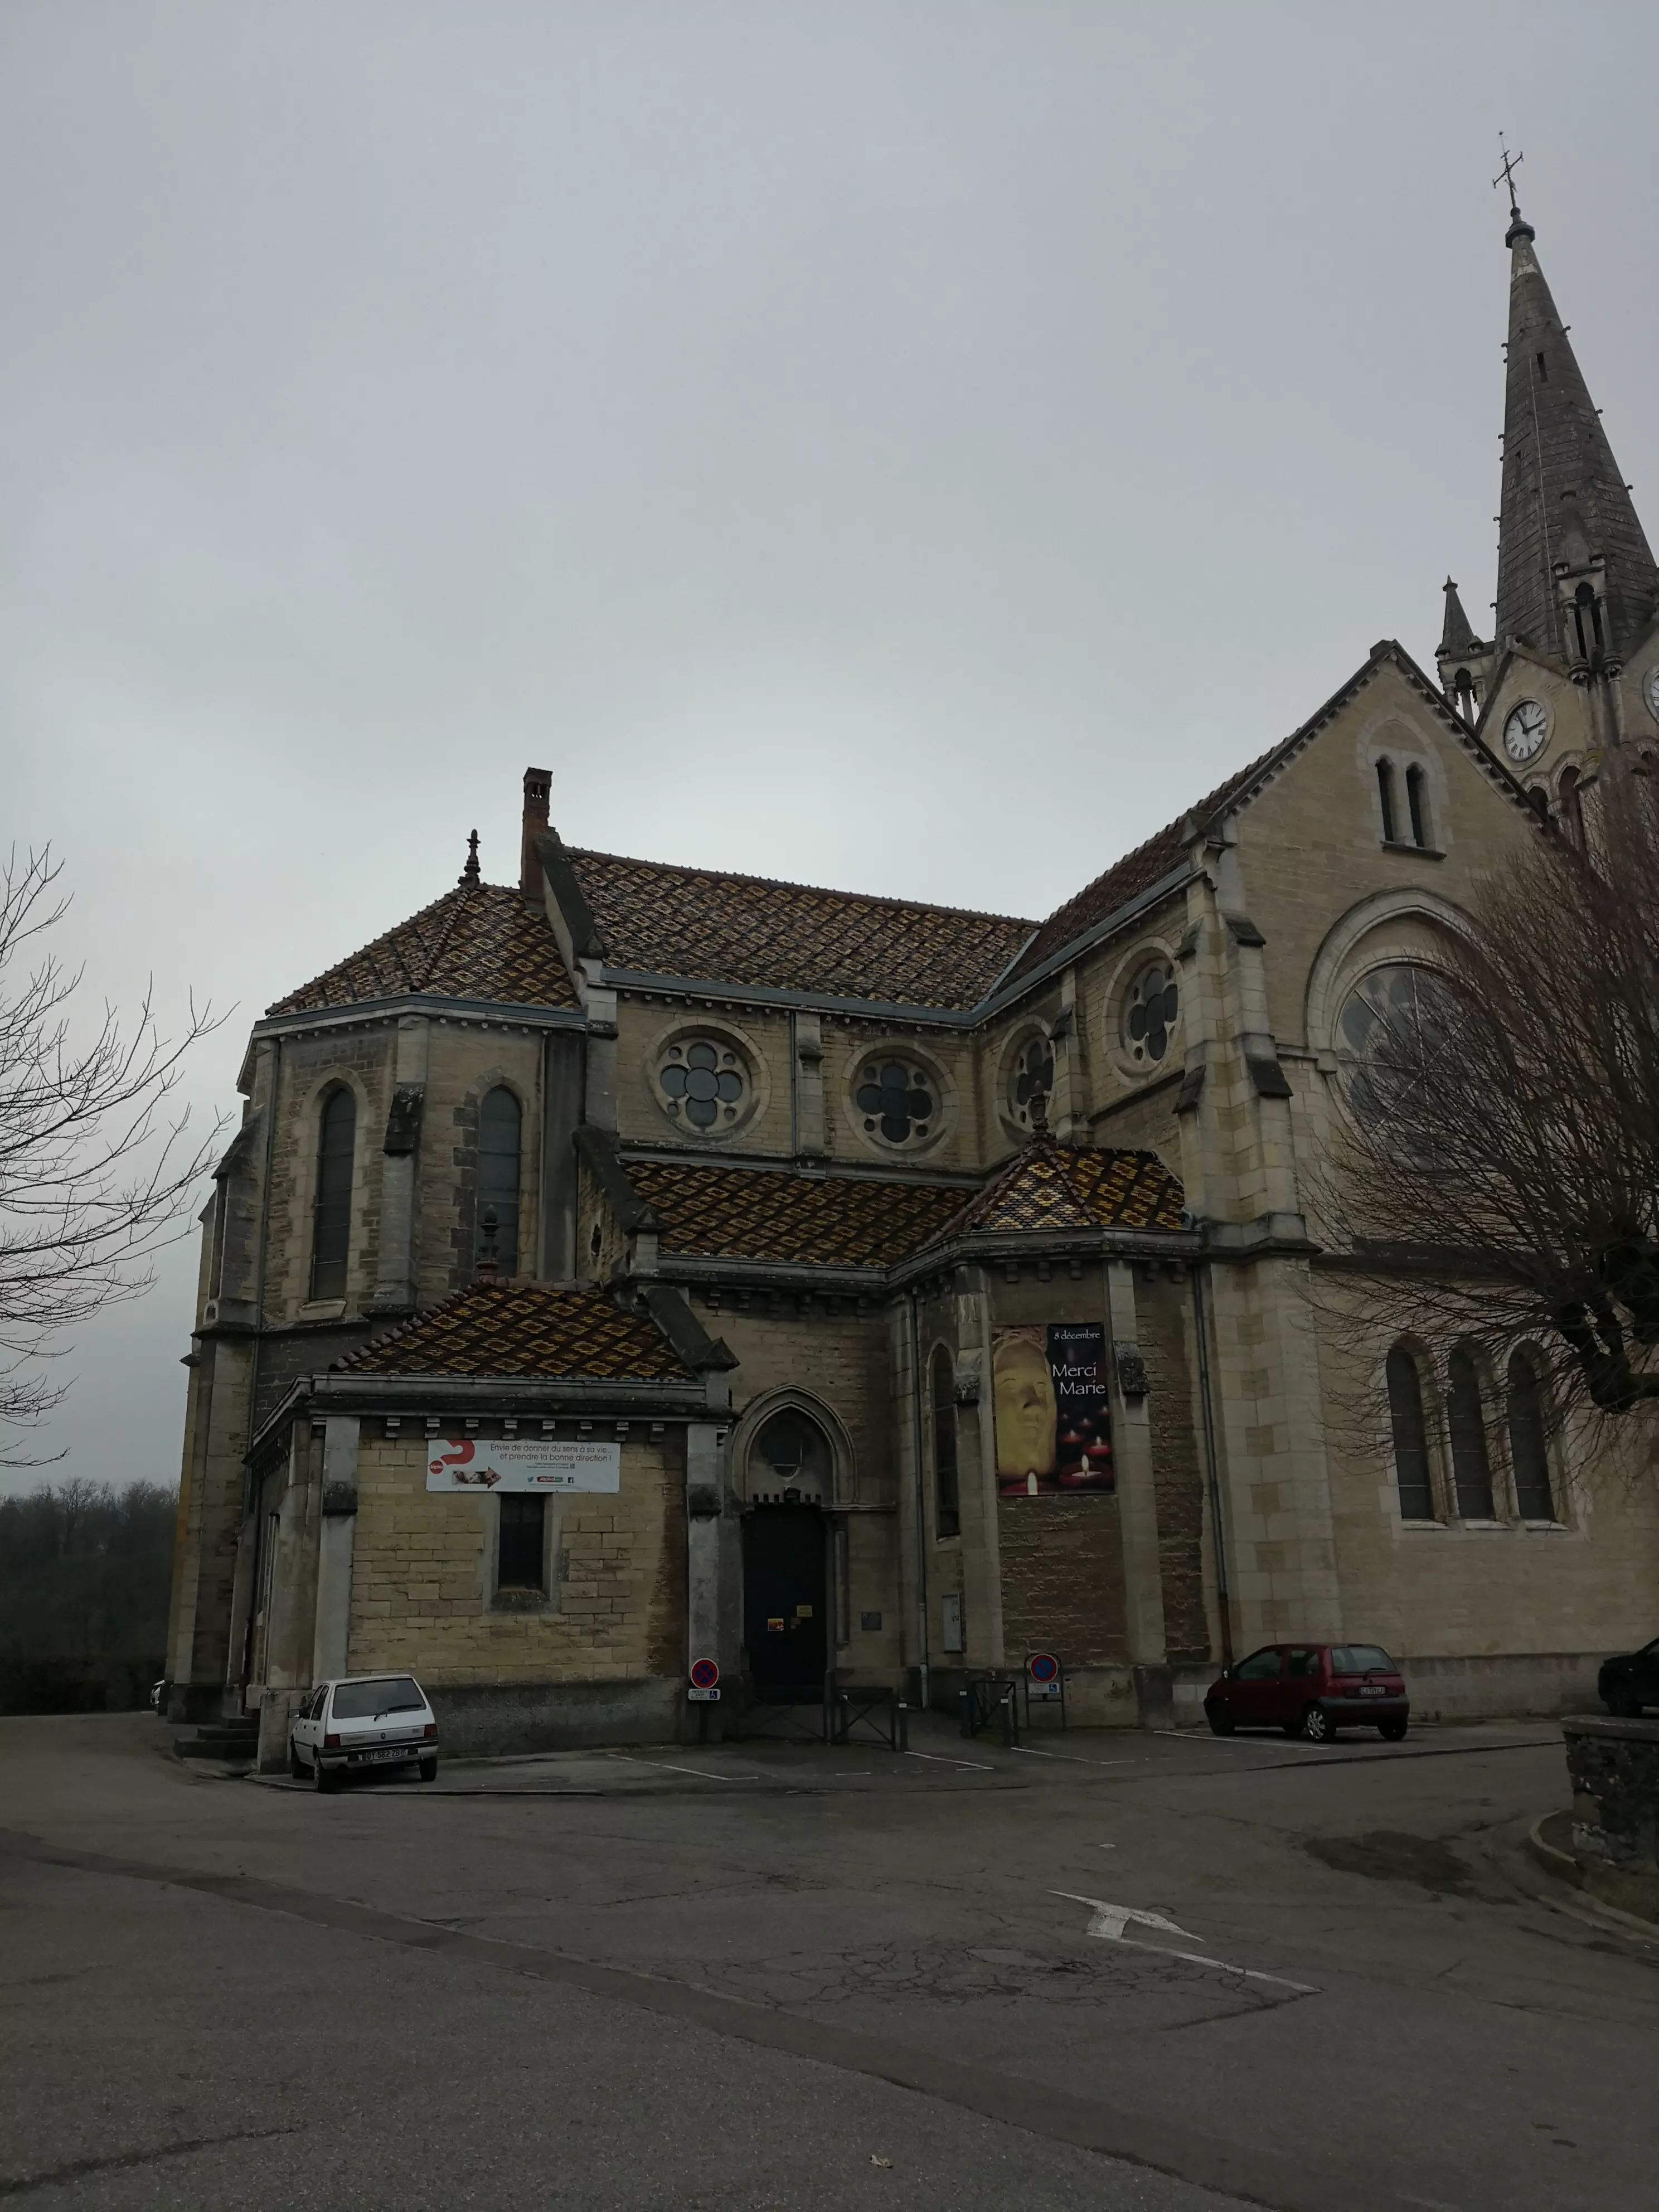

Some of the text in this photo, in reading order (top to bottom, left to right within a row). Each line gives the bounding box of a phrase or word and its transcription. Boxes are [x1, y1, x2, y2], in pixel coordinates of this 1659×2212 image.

[1054, 1328, 1102, 1340] 8 décembre
[1052, 1361, 1097, 1377] Merci
[1060, 1380, 1106, 1395] Marie
[508, 1453, 539, 1462] prendre
